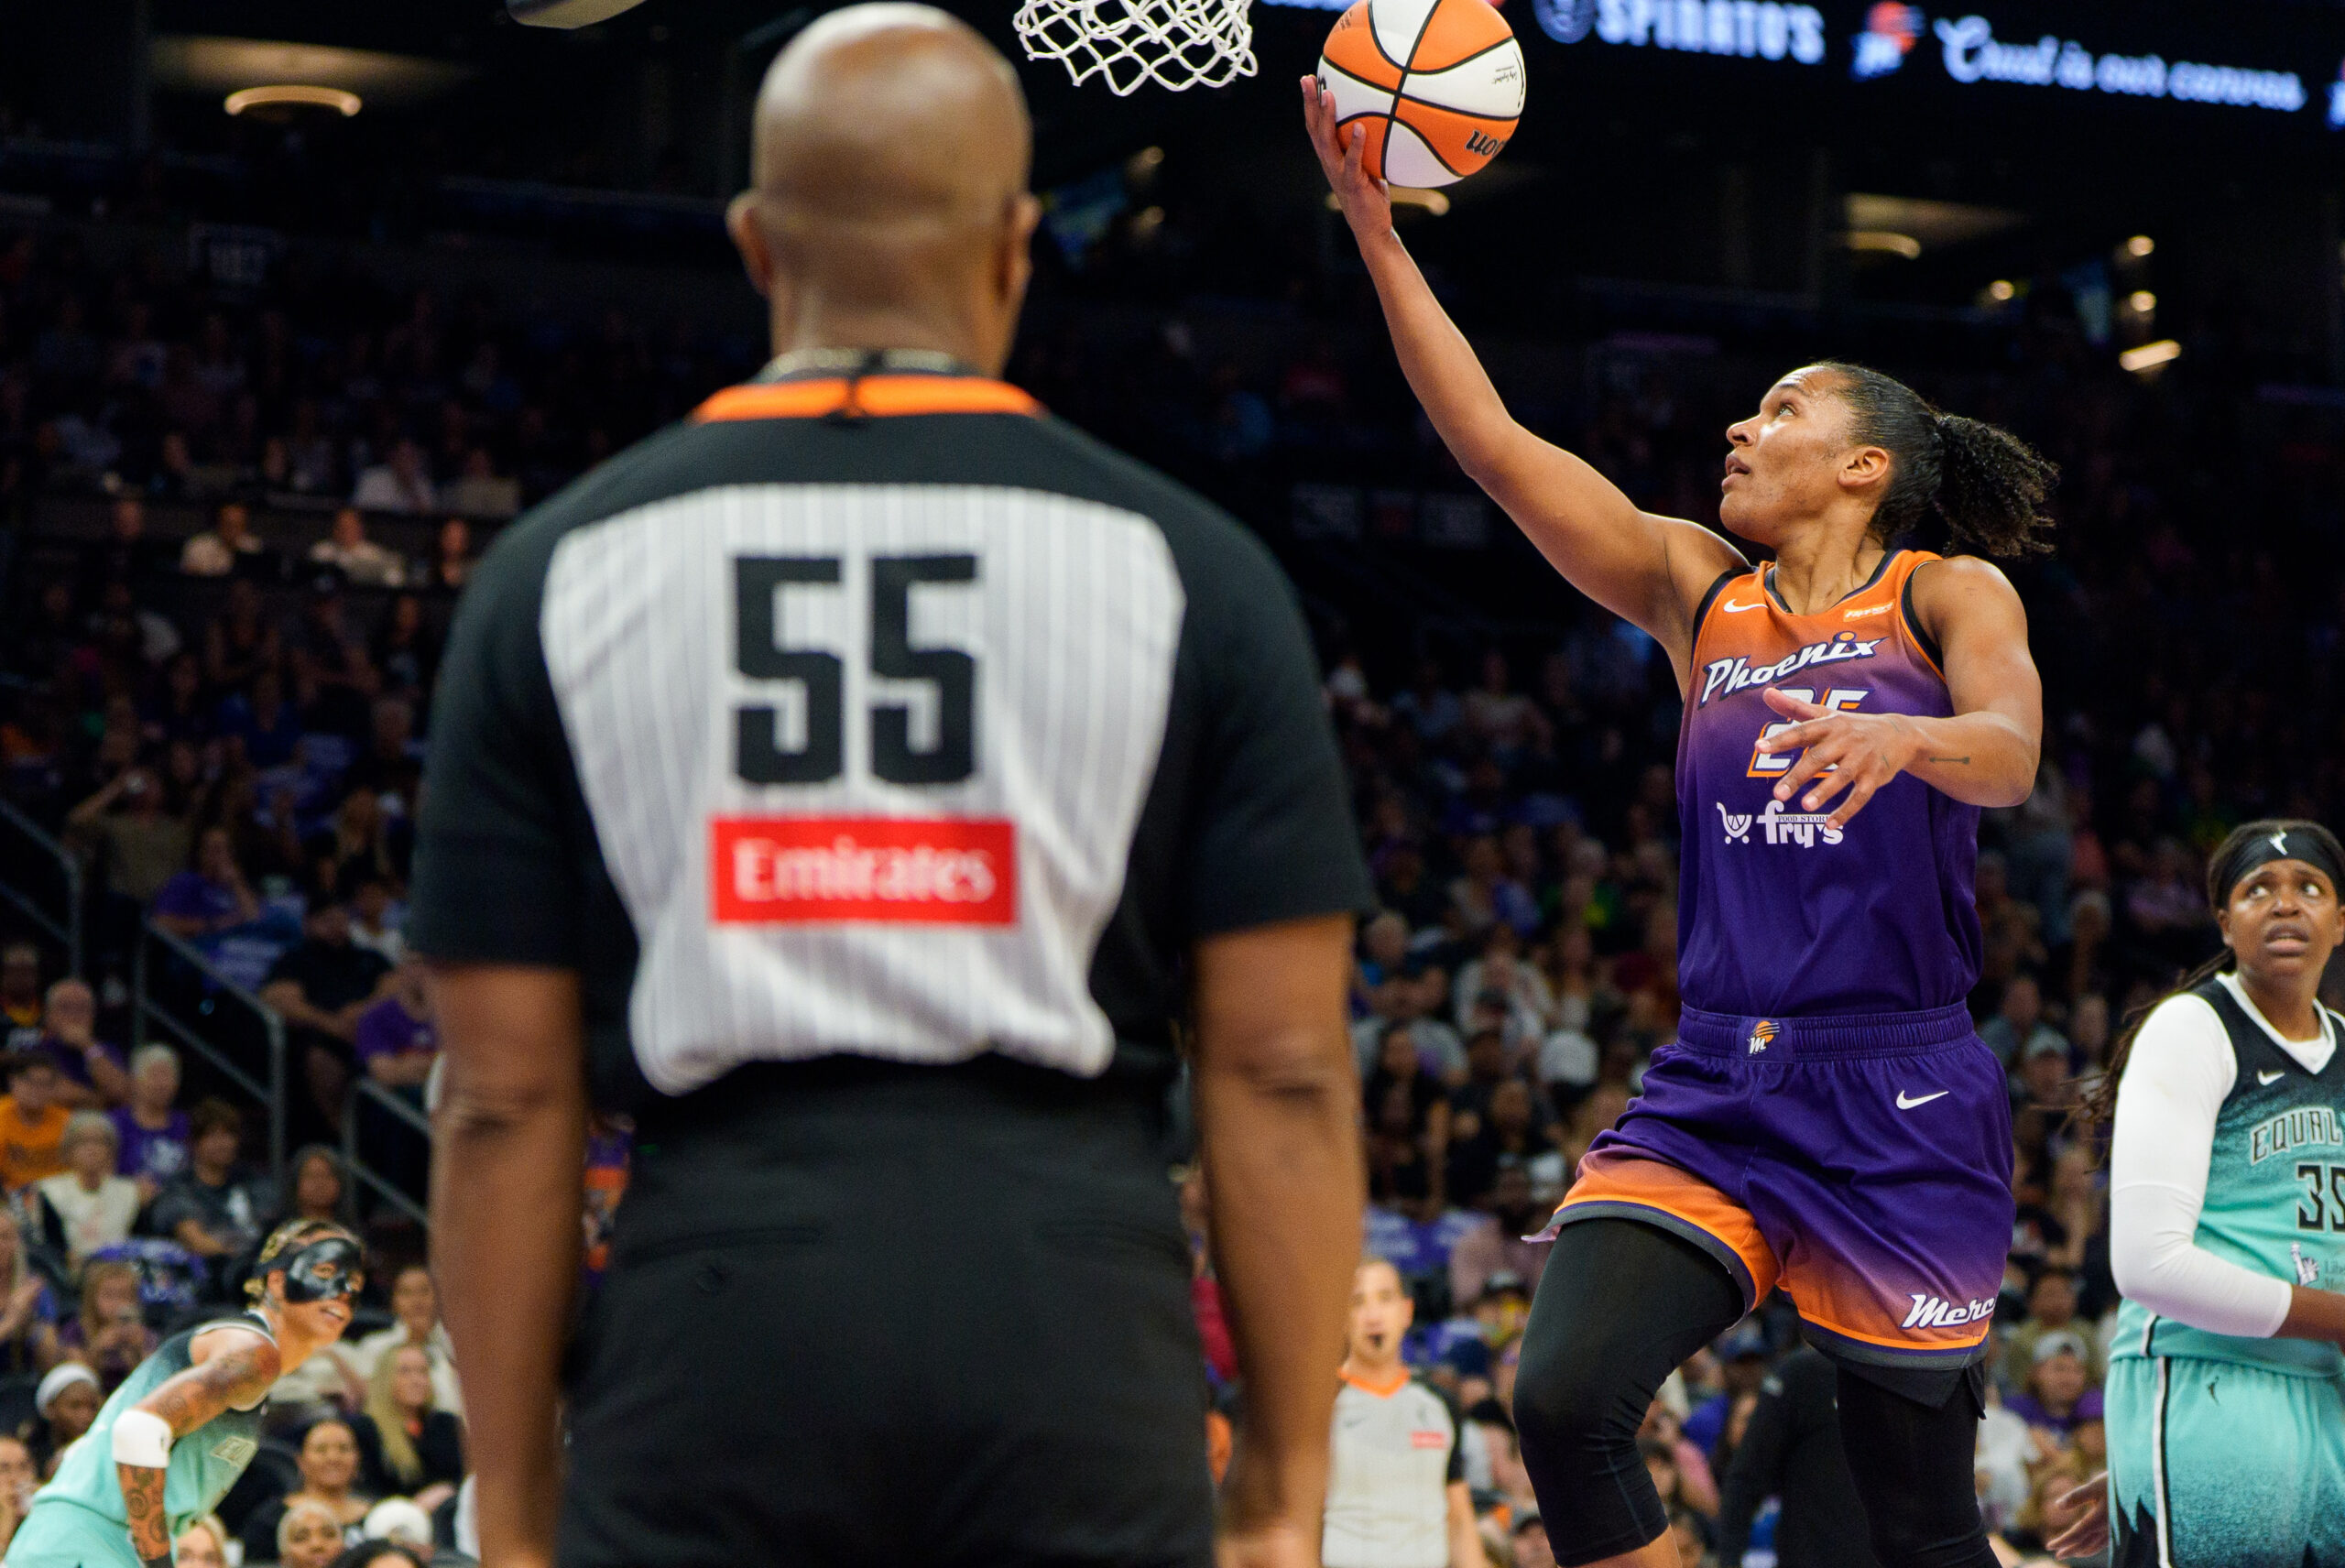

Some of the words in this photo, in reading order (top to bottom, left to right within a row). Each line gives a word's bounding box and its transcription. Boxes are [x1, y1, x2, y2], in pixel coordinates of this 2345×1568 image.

[735, 555, 977, 785] 55
[1698, 631, 1890, 709] Phoenix
[1756, 800, 1843, 848] fry's
[734, 835, 997, 903] Emirates
[2250, 1106, 2343, 1166] EQUAL
[1899, 1293, 1996, 1330] Merc
